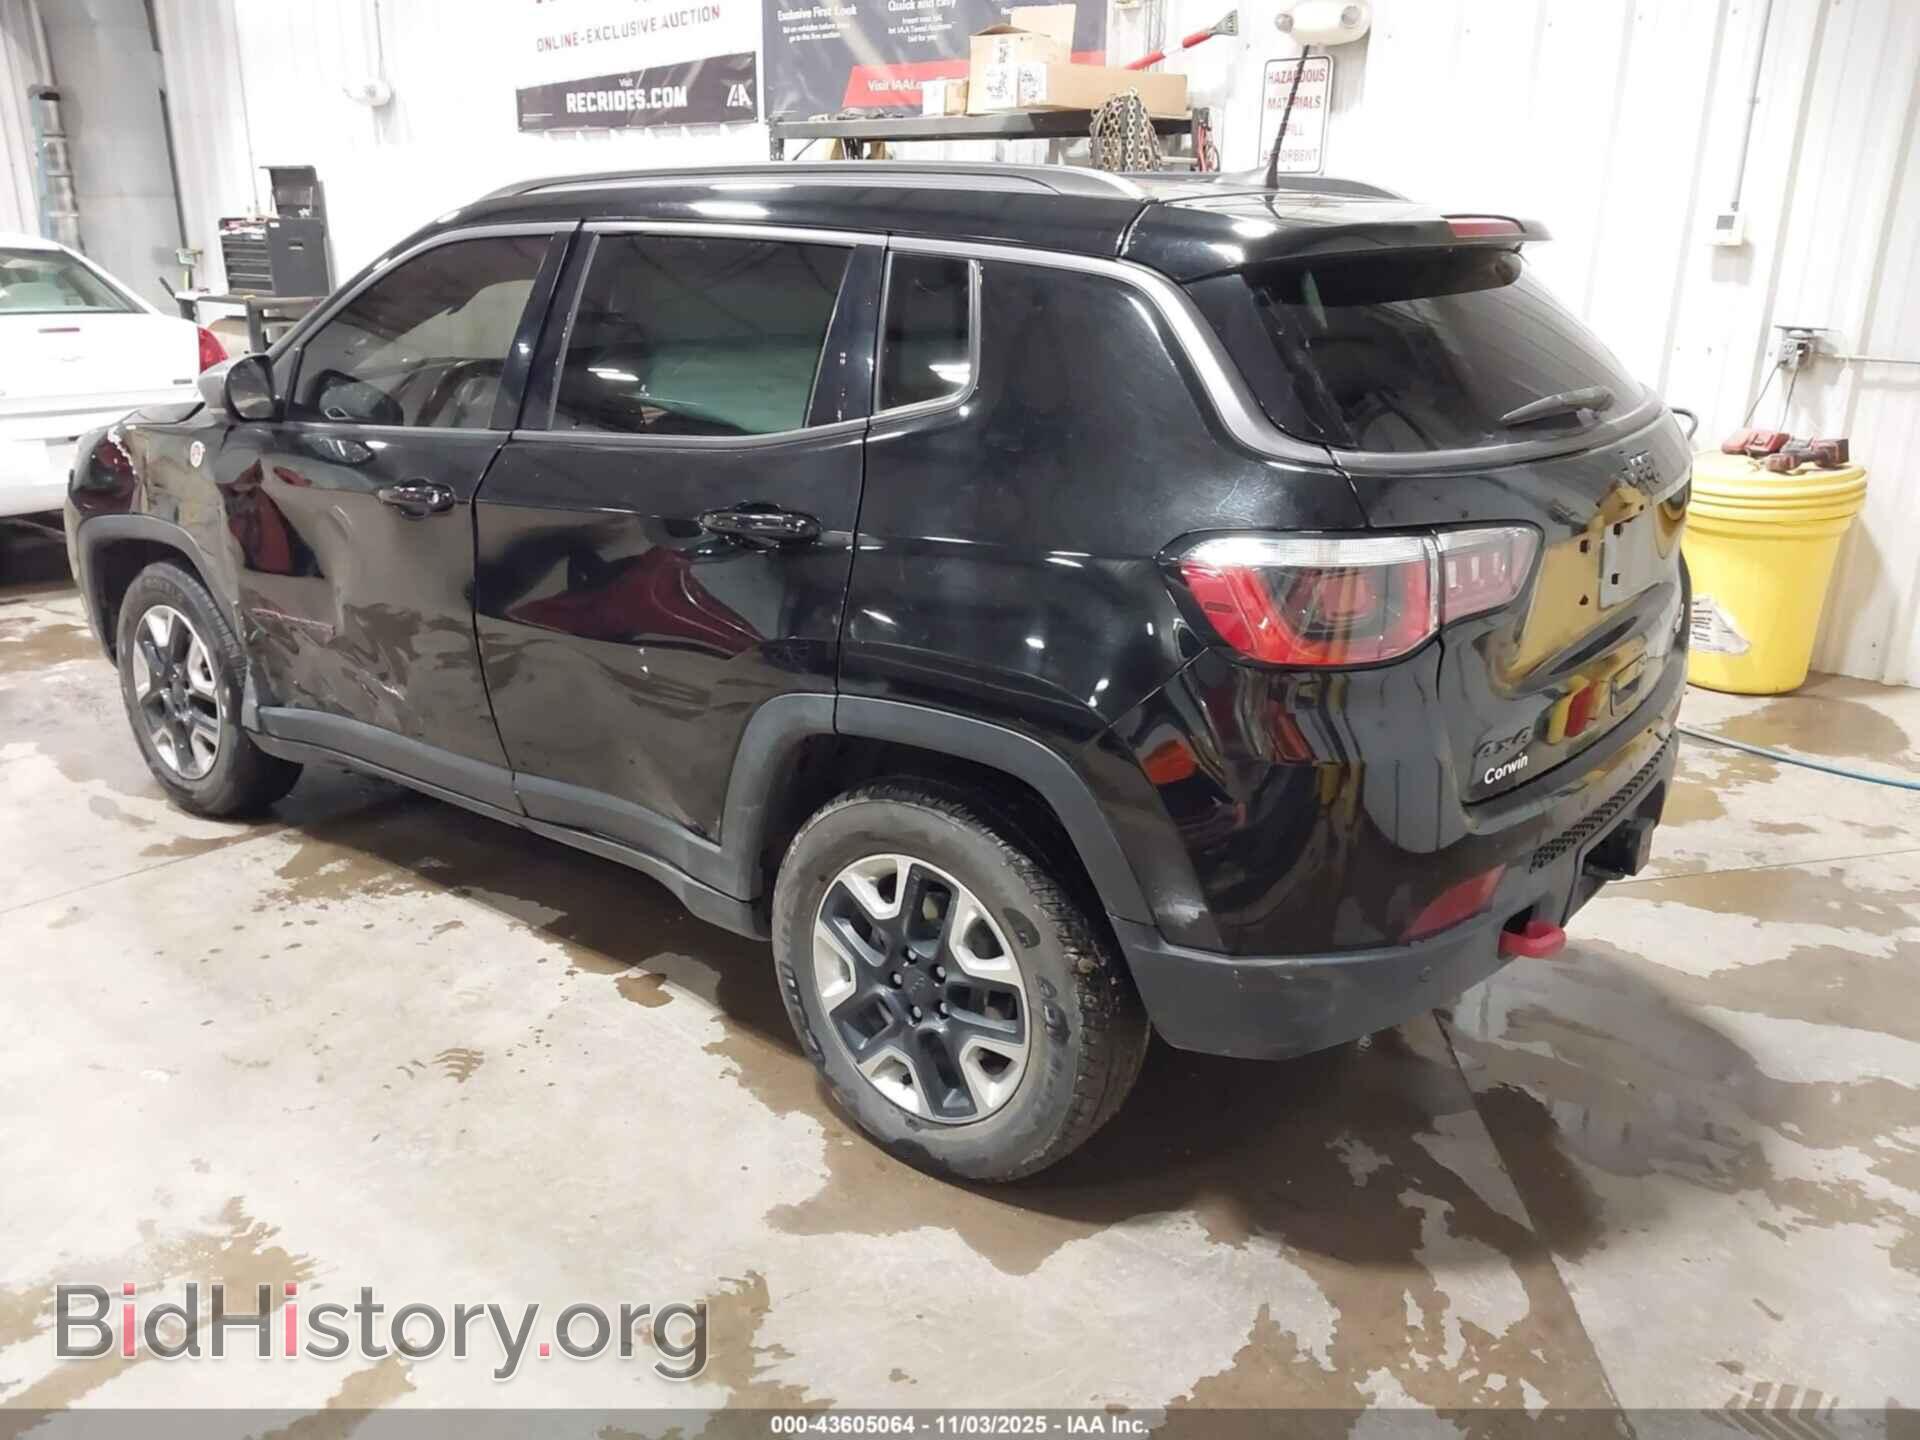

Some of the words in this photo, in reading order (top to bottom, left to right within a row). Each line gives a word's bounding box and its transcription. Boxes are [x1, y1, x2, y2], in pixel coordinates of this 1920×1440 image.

[536, 17, 656, 52] ONLINE-EXCLUSIVE
[661, 5, 720, 29] AUCTION
[1268, 68, 1325, 84] HAZADOUS
[566, 86, 688, 113] RECRIDES.COM
[1267, 95, 1322, 109] MATRIALS
[1262, 147, 1318, 163] AORBENT
[1484, 751, 1529, 785] Corwin
